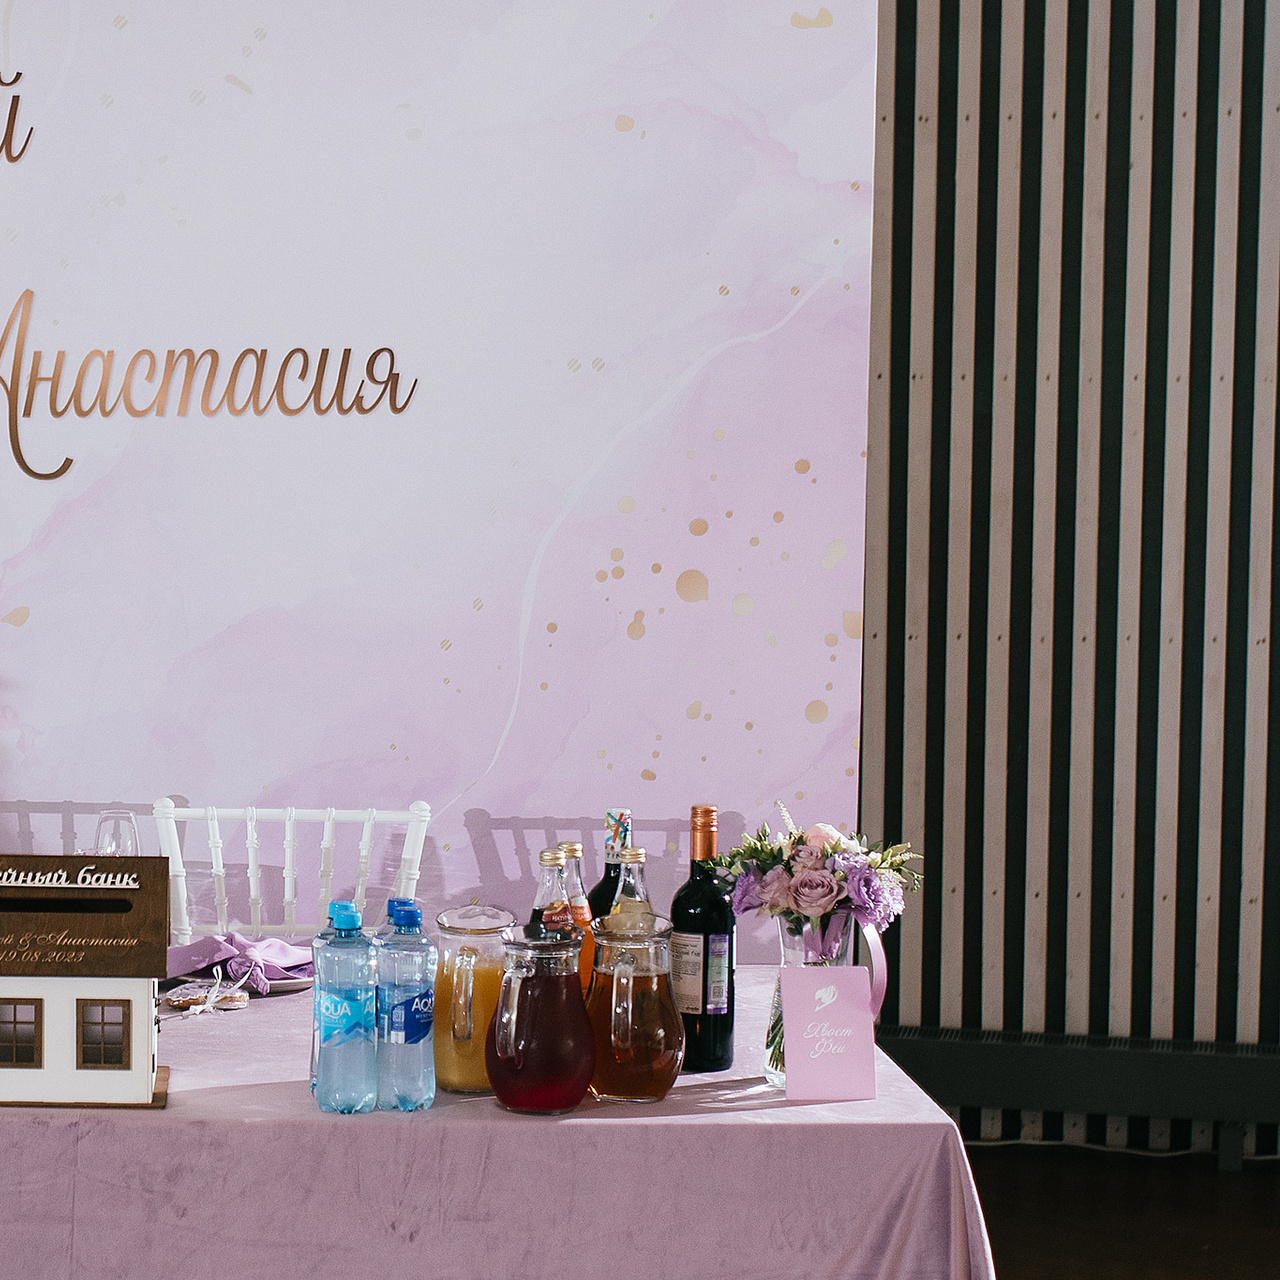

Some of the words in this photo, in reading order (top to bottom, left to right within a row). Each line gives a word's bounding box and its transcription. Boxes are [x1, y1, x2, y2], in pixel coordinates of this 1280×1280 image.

[77, 865, 140, 888] банк
[17, 932, 37, 951] &
[36, 929, 139, 946] Анастасия
[321, 1003, 351, 1018] QUA
[803, 1022, 853, 1038] Хвост
[810, 1039, 847, 1058] Феи
